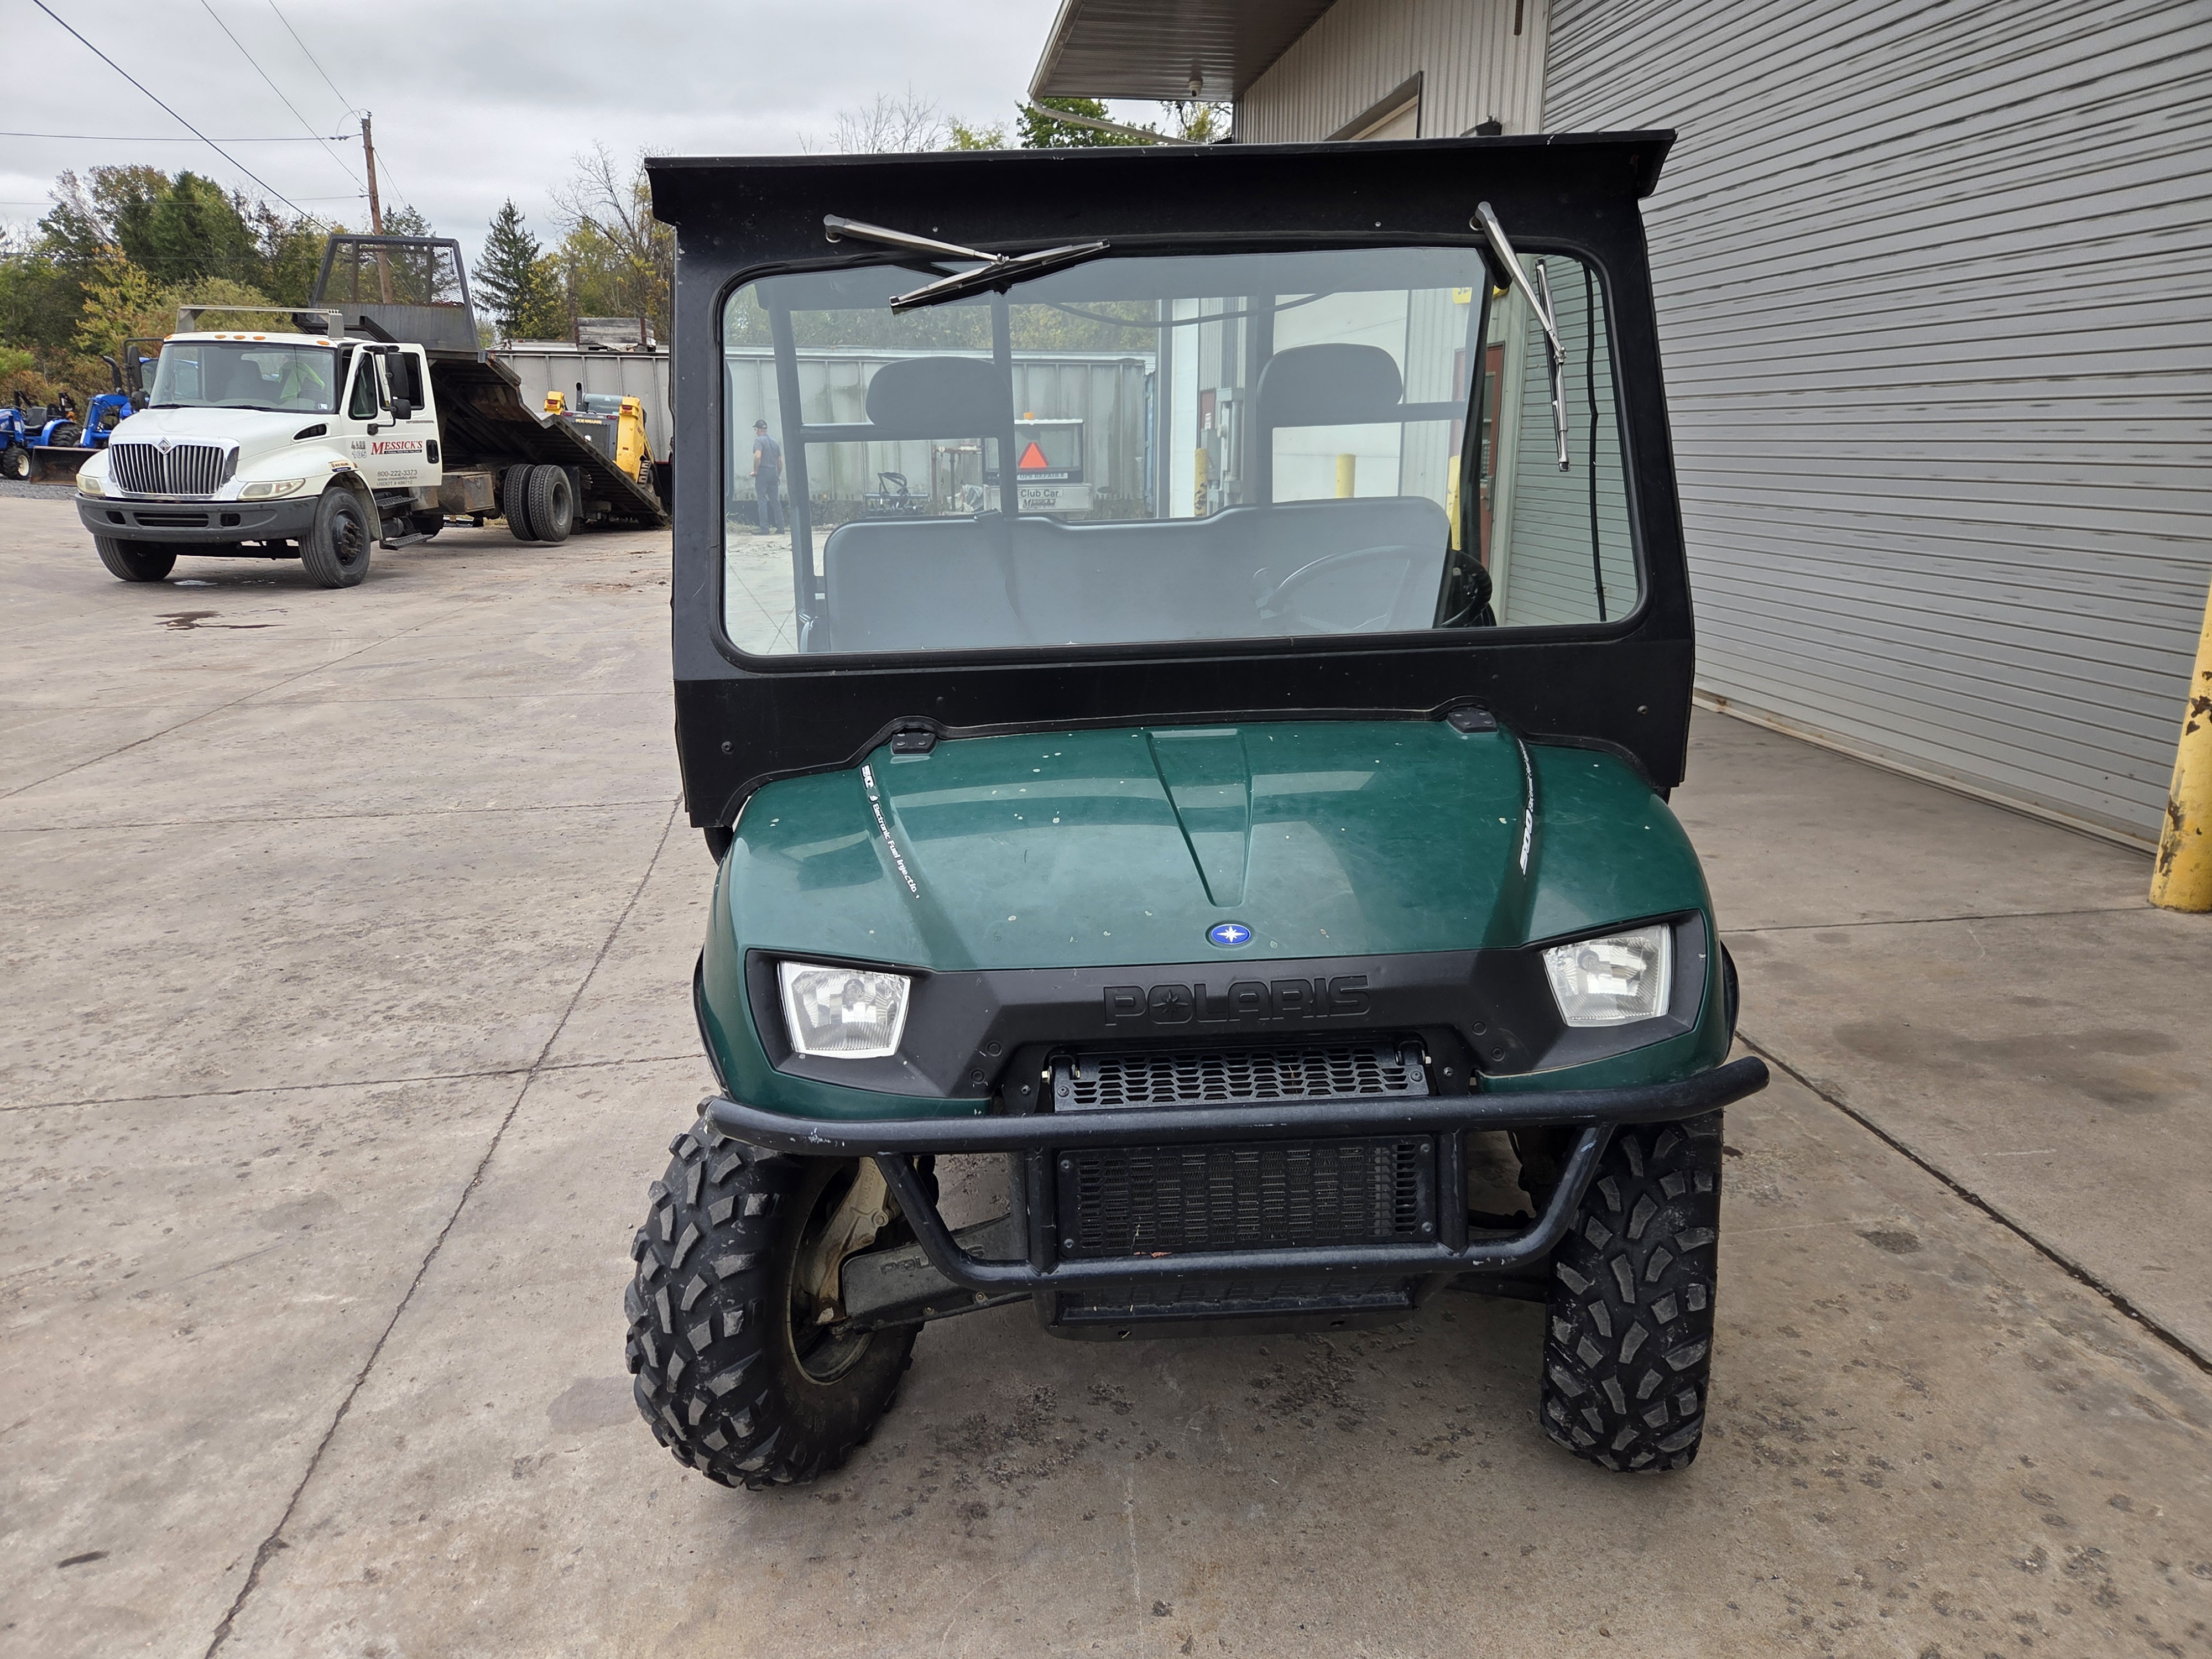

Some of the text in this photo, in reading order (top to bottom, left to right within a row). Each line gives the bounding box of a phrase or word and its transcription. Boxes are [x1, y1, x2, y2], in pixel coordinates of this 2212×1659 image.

[352, 450, 367, 459] 105
[371, 440, 422, 455] MESSICK'S
[873, 803, 891, 840] Electronic
[887, 839, 901, 858] Fuel
[896, 859, 920, 899] Injectio
[1103, 975, 1370, 1026] POLARIS
